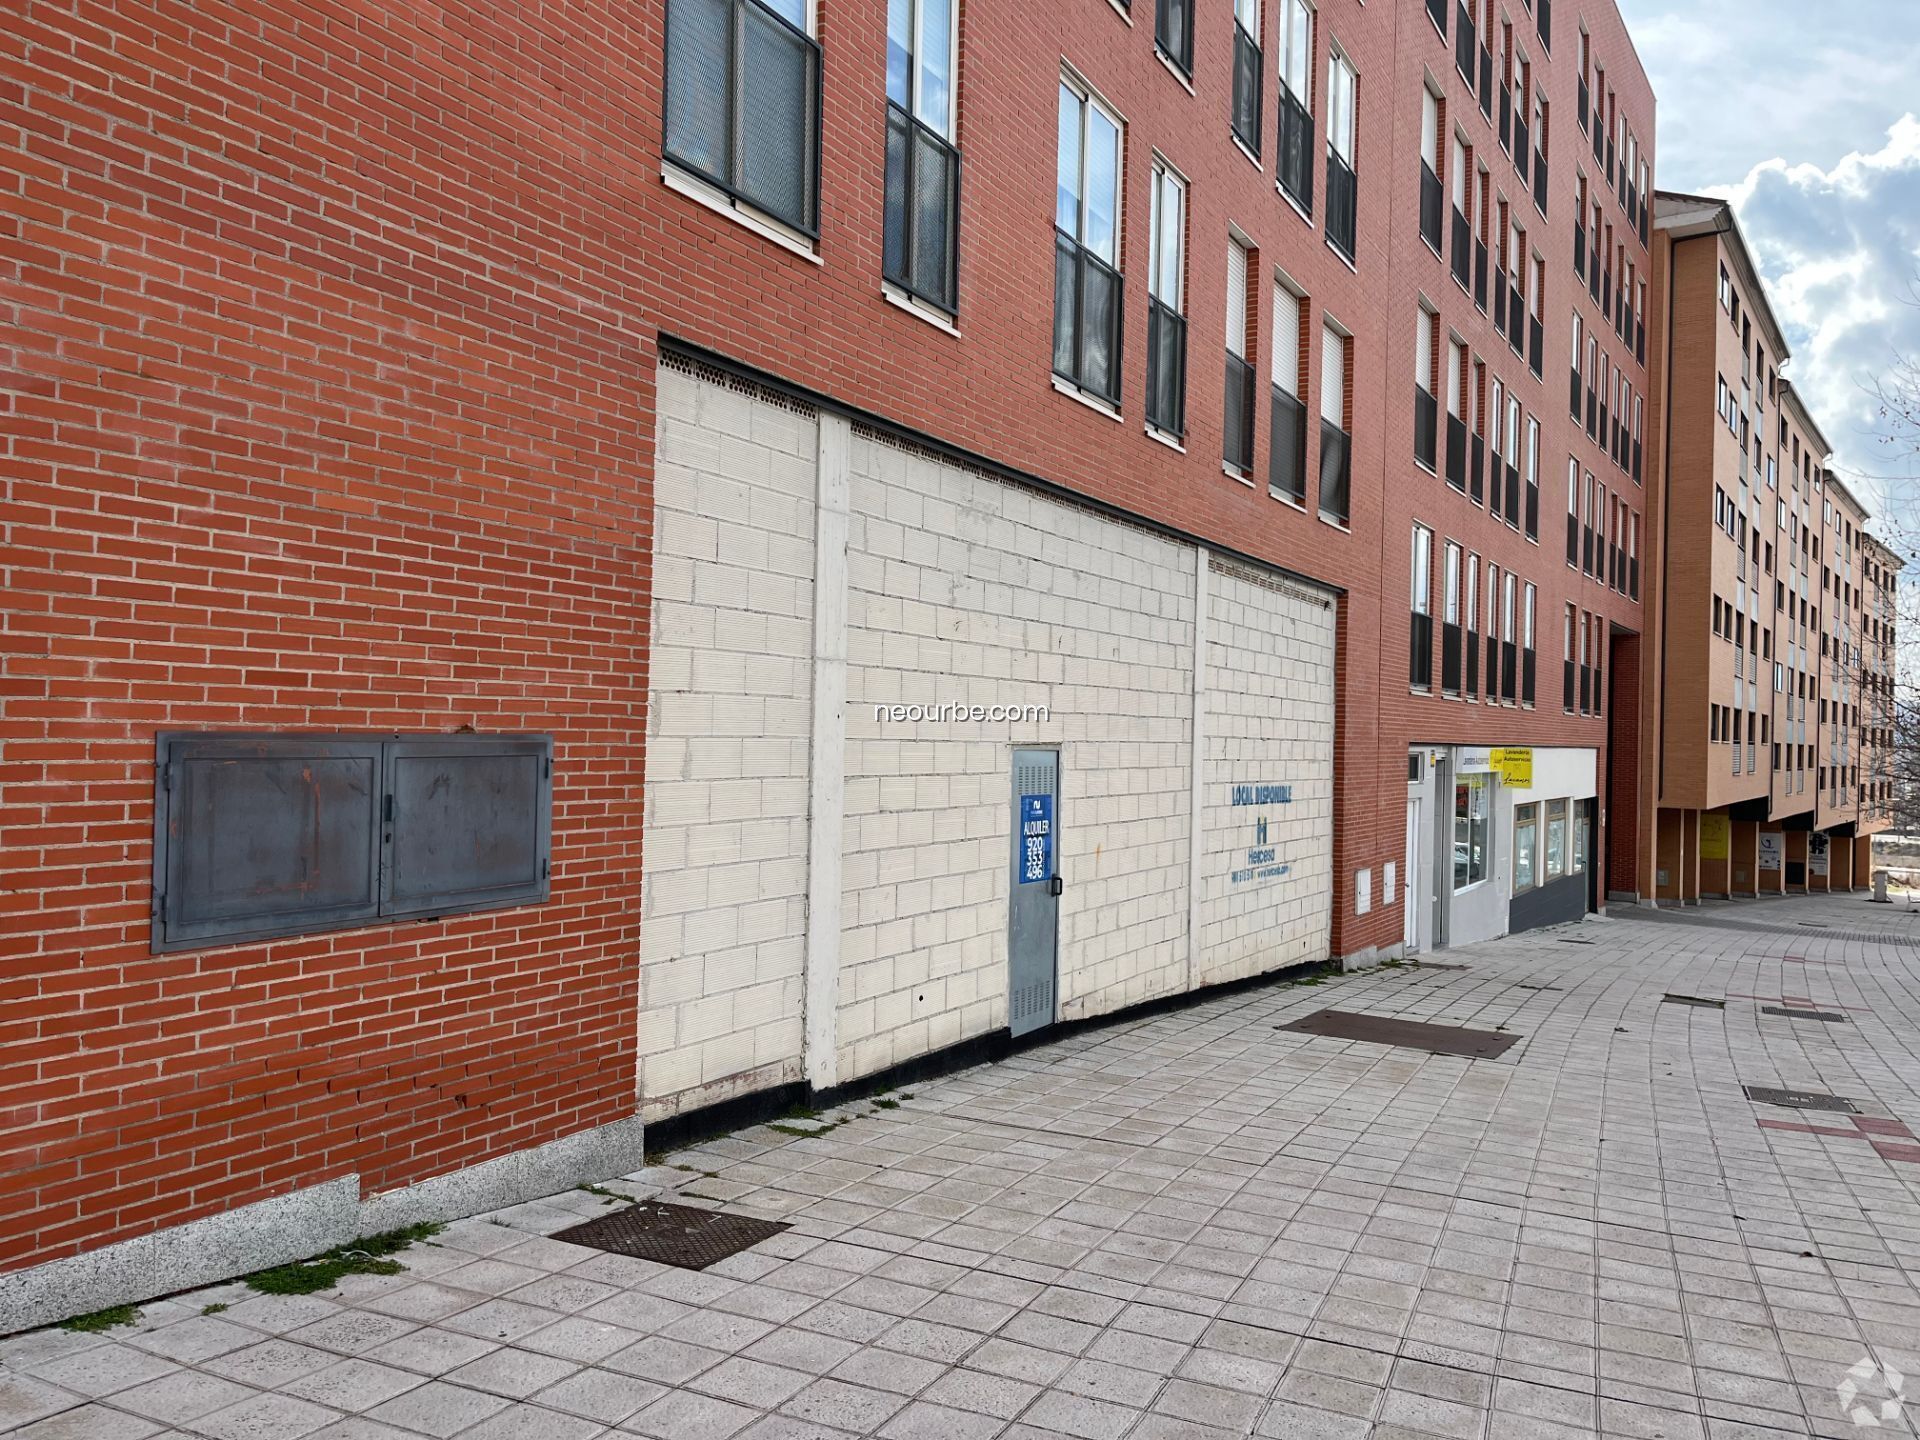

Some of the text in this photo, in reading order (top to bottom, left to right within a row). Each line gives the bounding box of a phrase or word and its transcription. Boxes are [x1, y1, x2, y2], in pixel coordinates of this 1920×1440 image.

[1232, 785, 1292, 806] LOCAL DISPONIBLE
[1023, 820, 1050, 836] ALQUILER
[1027, 836, 1043, 852] 920
[1026, 851, 1043, 866] 353
[1026, 864, 1043, 880] 496
